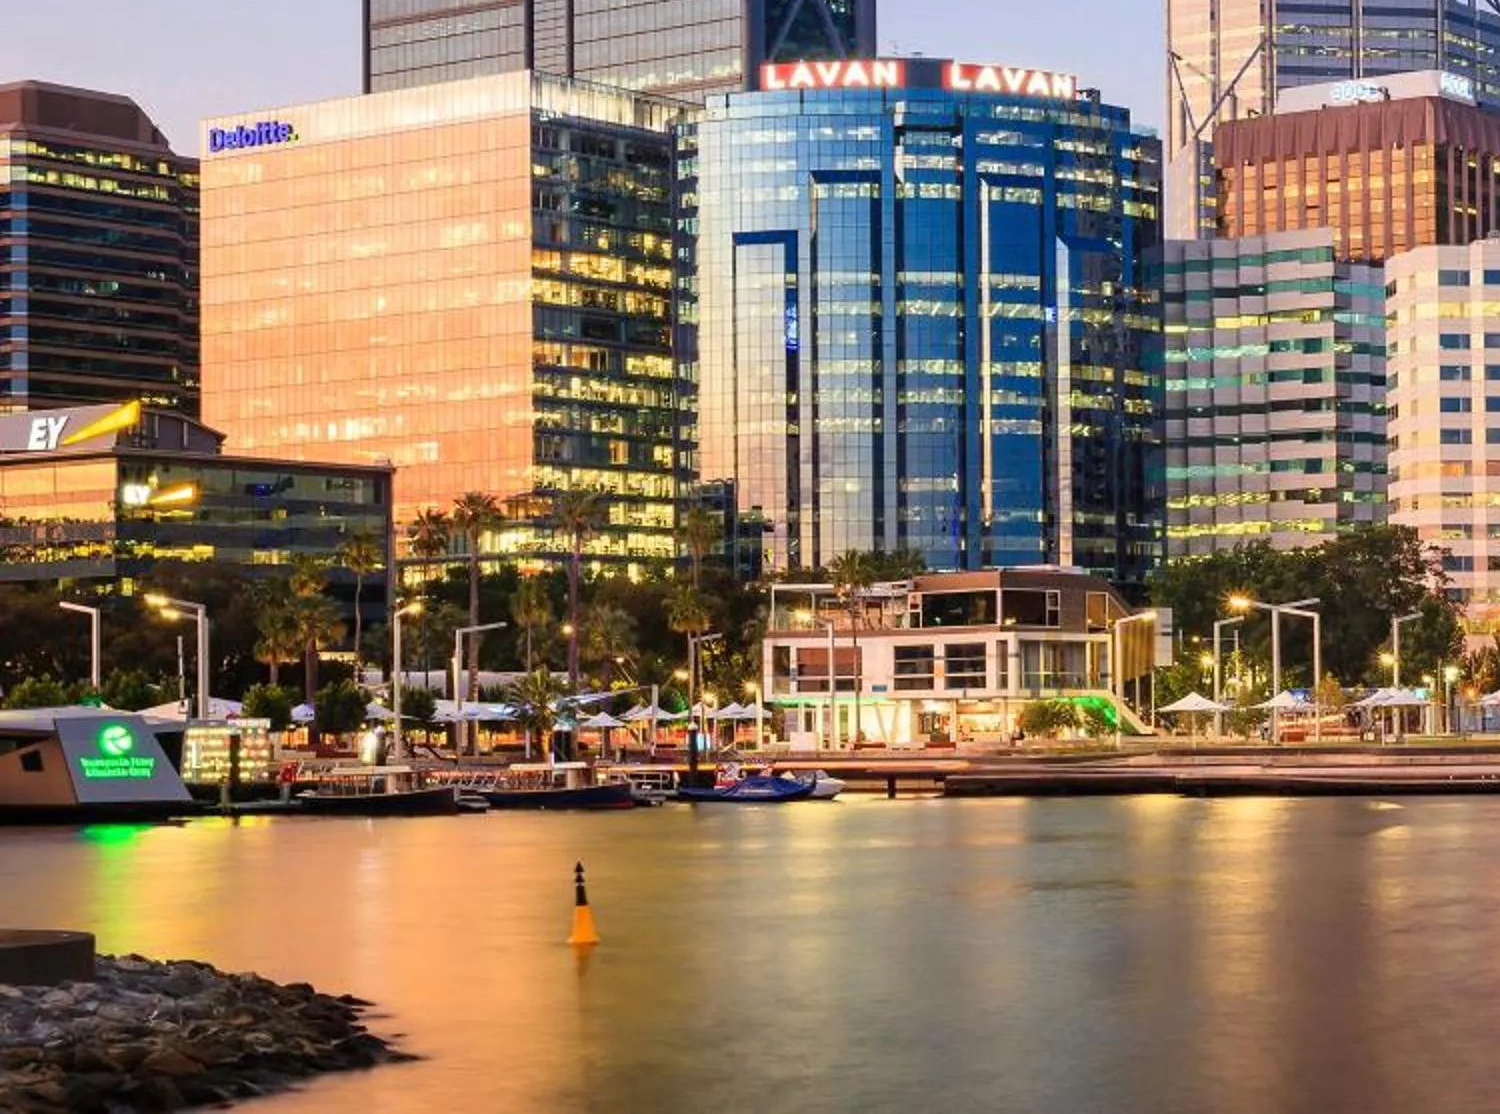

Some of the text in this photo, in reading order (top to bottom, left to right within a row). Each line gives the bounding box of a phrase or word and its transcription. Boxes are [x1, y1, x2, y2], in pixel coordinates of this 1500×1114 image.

[766, 59, 899, 89] LAVAN
[950, 56, 1074, 98] LAVAN
[28, 416, 69, 450] EY
